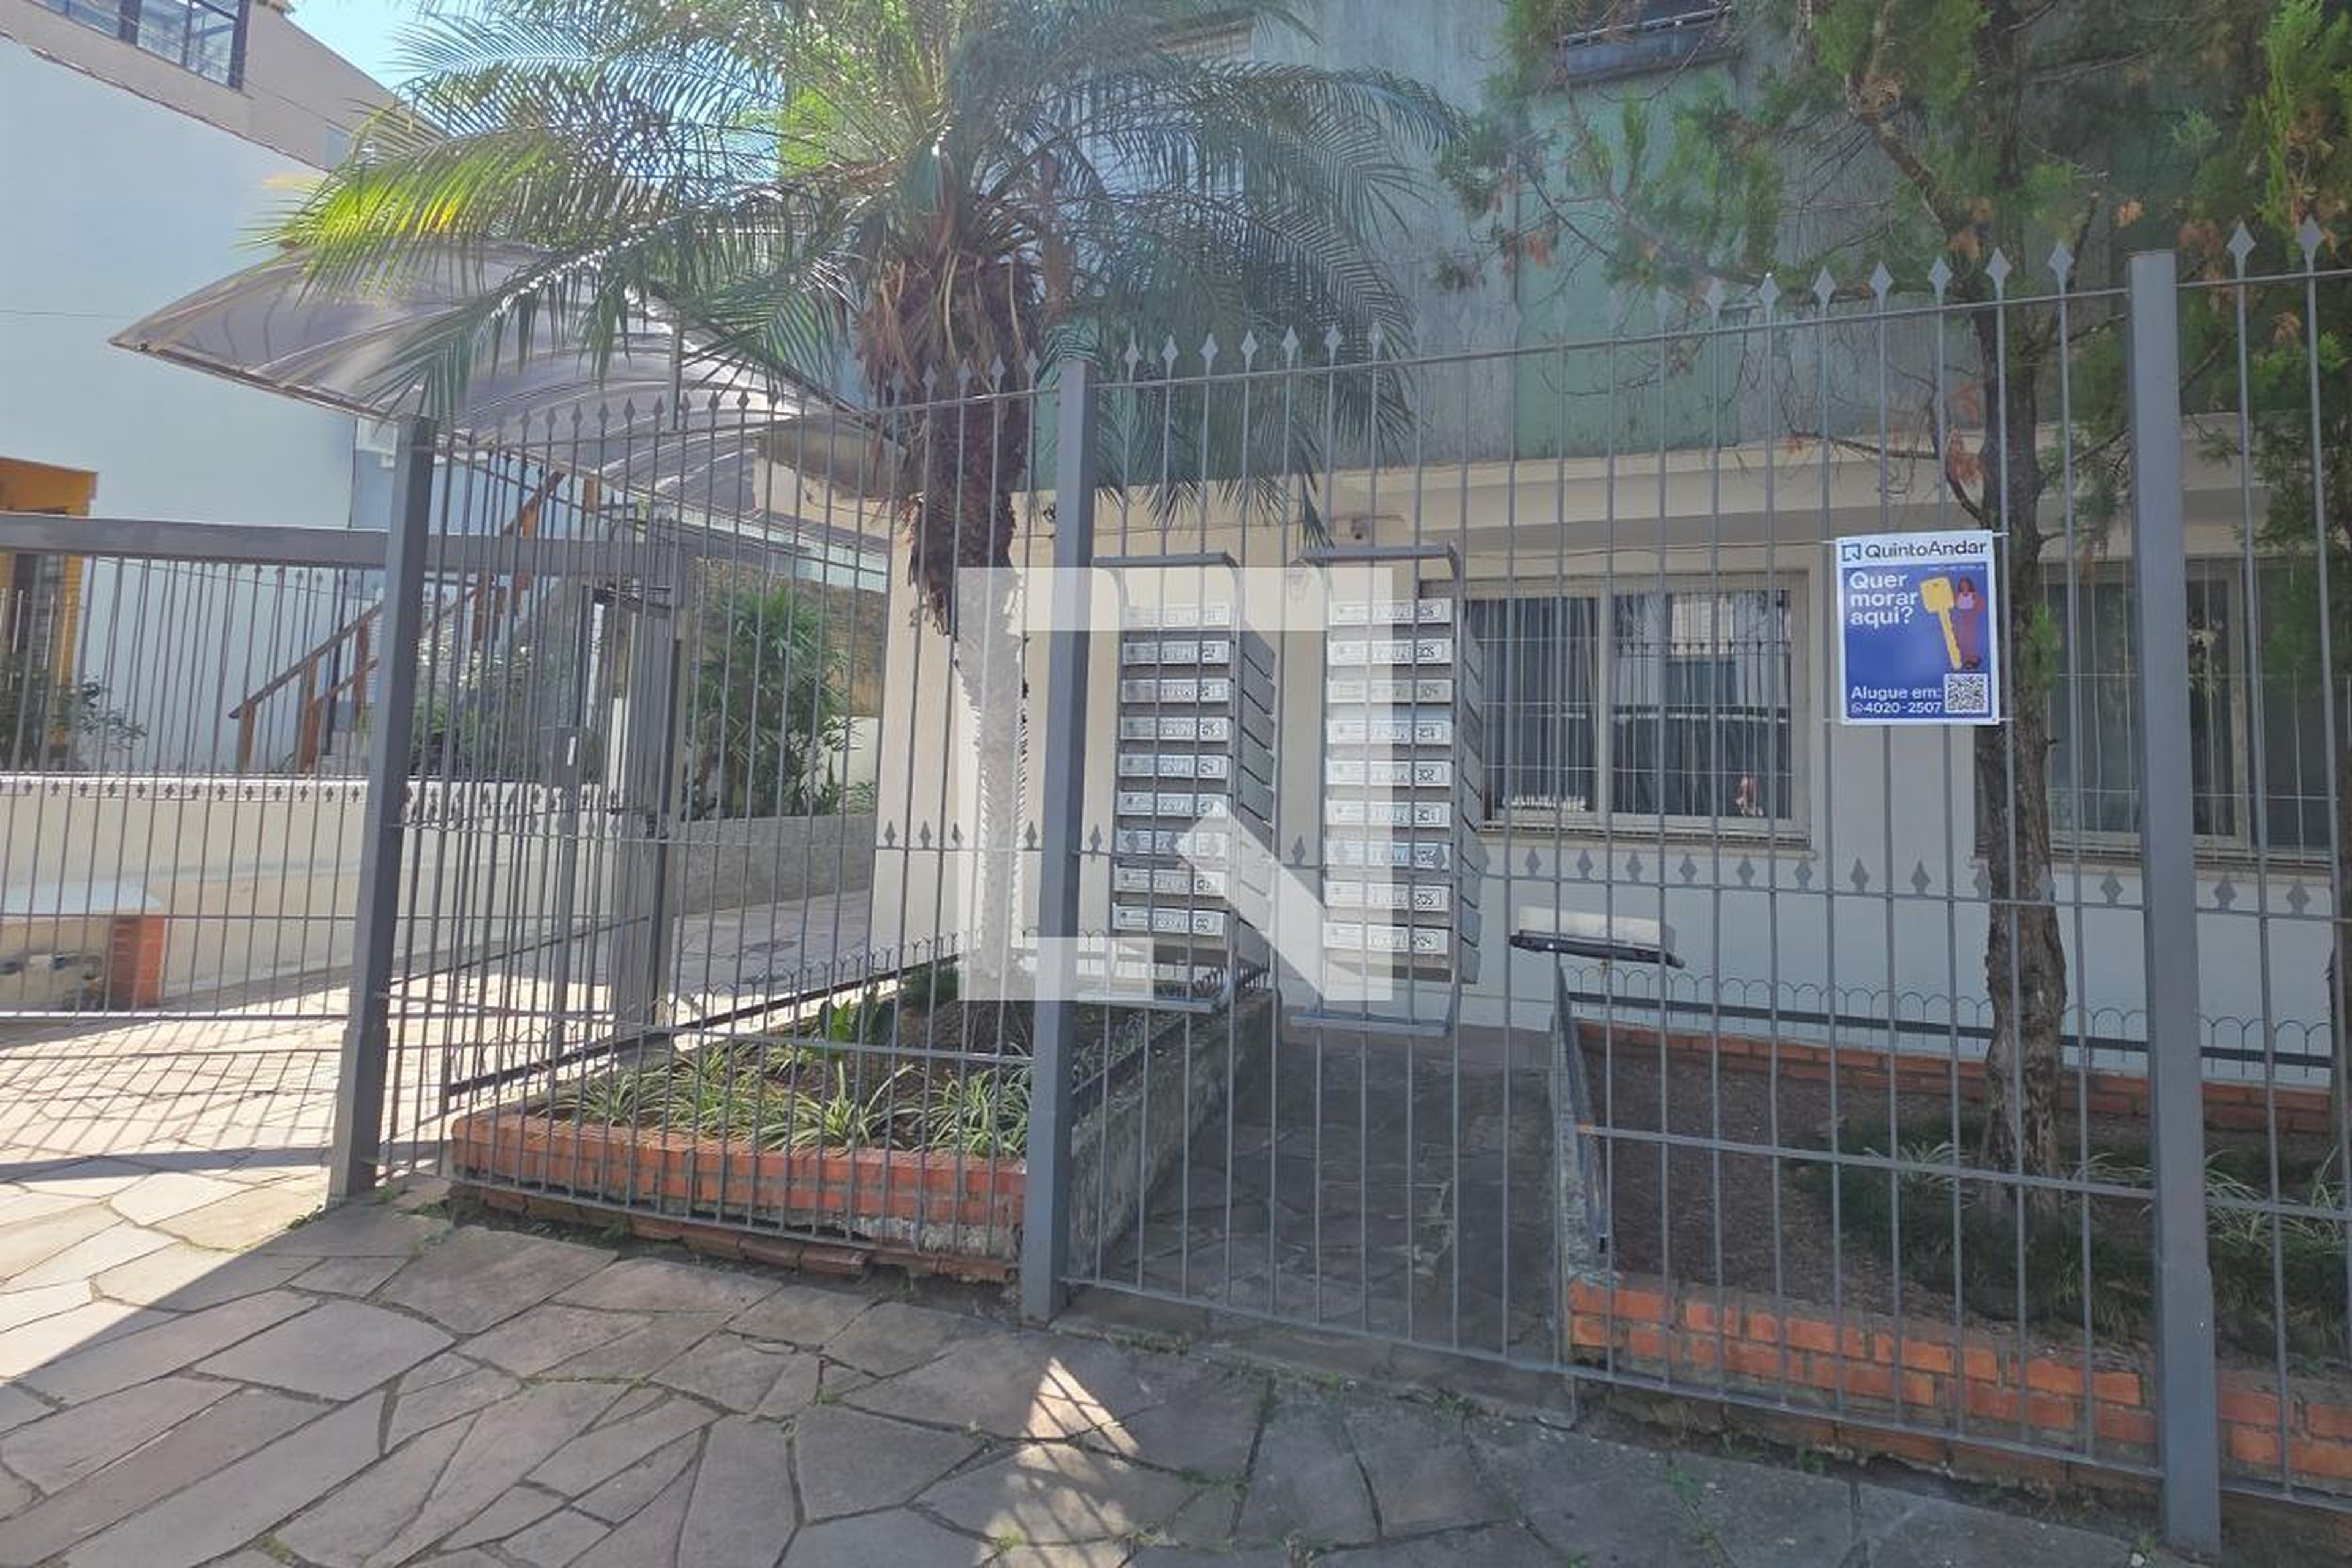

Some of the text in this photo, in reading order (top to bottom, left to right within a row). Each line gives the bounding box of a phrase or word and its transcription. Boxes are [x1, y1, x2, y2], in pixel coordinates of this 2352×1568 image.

[1865, 540, 1987, 558] QuintoAndar
[1850, 571, 1908, 589] Quer
[1850, 592, 1918, 607] morar
[1850, 606, 1913, 629] aqui?
[1851, 685, 1942, 701] Alugue em:
[1864, 701, 1942, 714] 4020-2507
